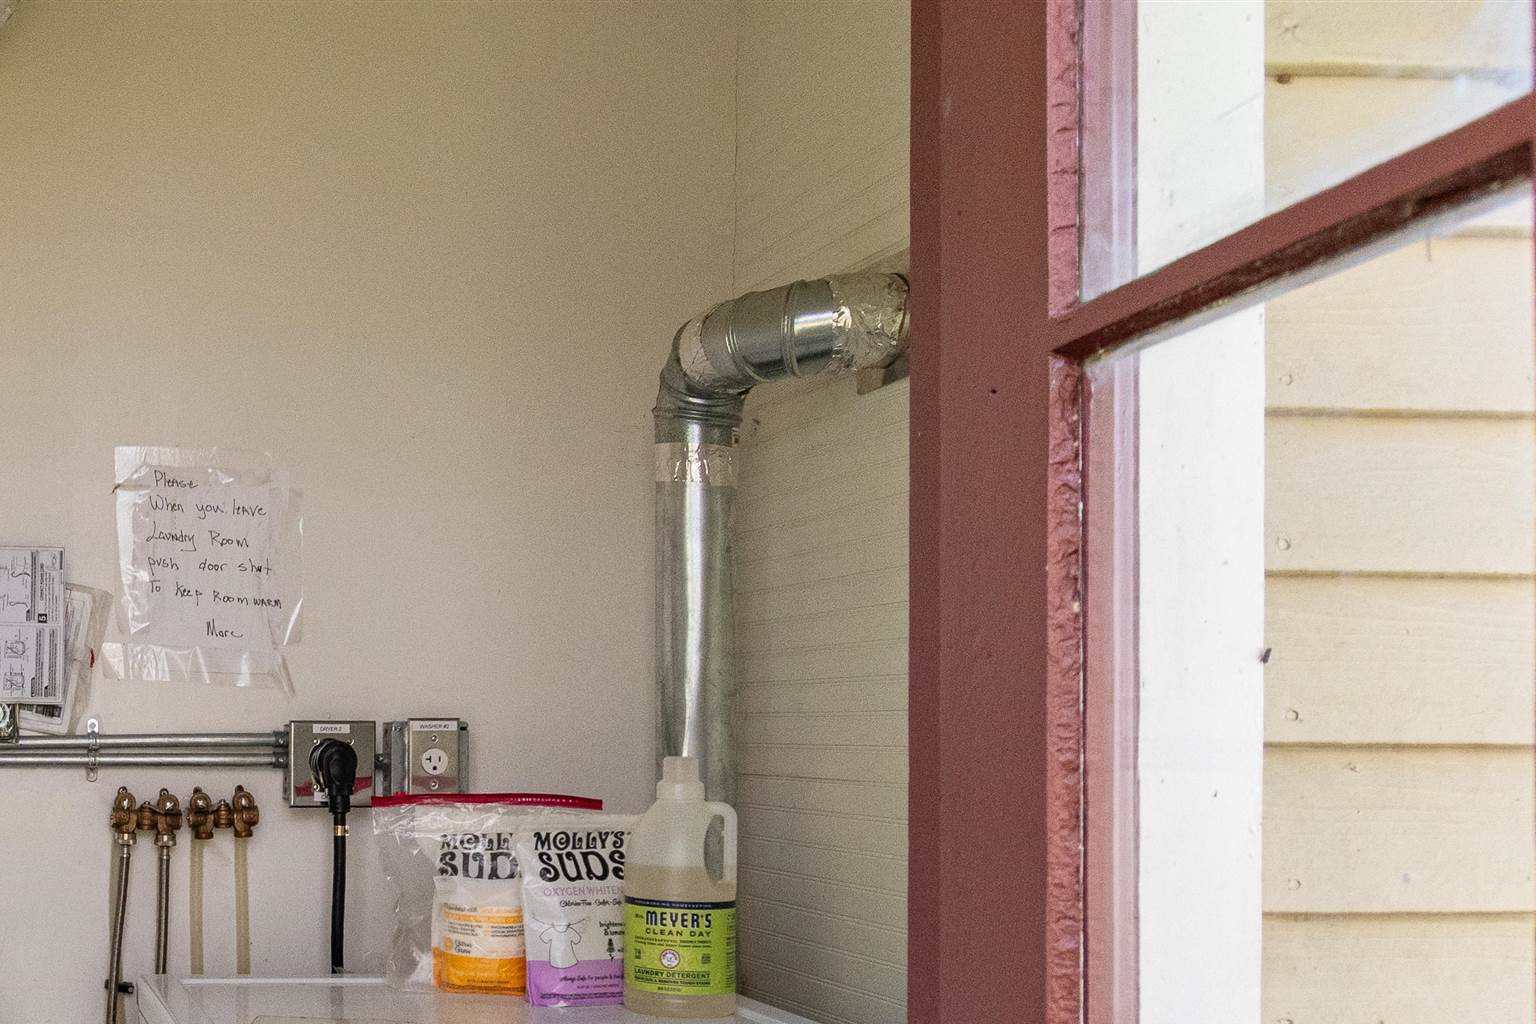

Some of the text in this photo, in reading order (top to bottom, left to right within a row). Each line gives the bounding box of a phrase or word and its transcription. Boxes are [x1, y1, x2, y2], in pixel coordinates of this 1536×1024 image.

[154, 470, 199, 489] Please
[149, 494, 267, 519] When you leave
[145, 521, 249, 551] Laundry Room
[148, 556, 273, 576] push door shut
[149, 580, 161, 593] To
[213, 590, 249, 604] Room
[38, 614, 46, 622] 5
[440, 832, 513, 851] MOLL
[533, 831, 626, 851] MOLLY'S
[438, 851, 522, 880] SUD
[537, 850, 626, 882] SUDS
[543, 886, 586, 897] OXYGEN
[645, 910, 713, 929] MEYER'S
[645, 927, 713, 938] CLEAN DAY
[633, 967, 711, 980] LAUNDRY DETERGENT
